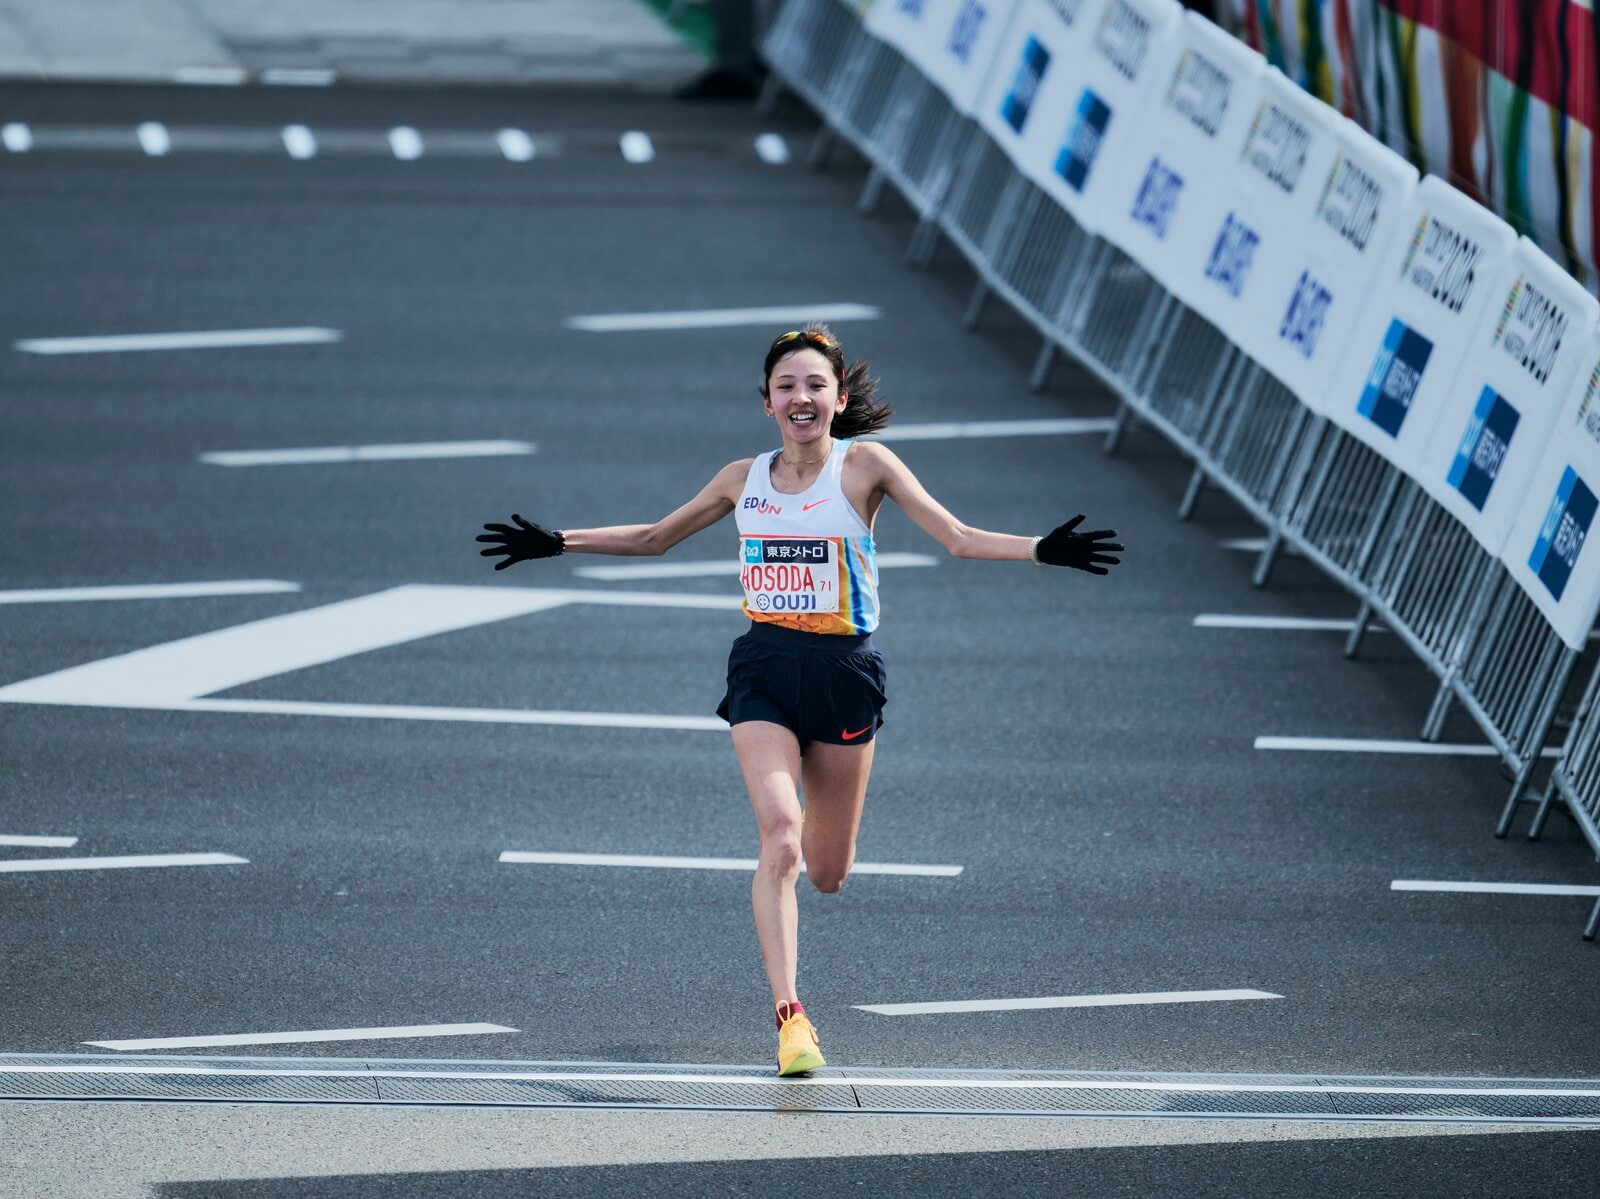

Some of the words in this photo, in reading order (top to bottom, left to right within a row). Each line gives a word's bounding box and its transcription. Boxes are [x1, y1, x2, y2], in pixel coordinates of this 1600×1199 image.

[766, 546, 824, 558] 東京メトロ
[742, 565, 815, 592] HOSODA
[820, 580, 832, 592] 71
[772, 594, 817, 610] OUJI
